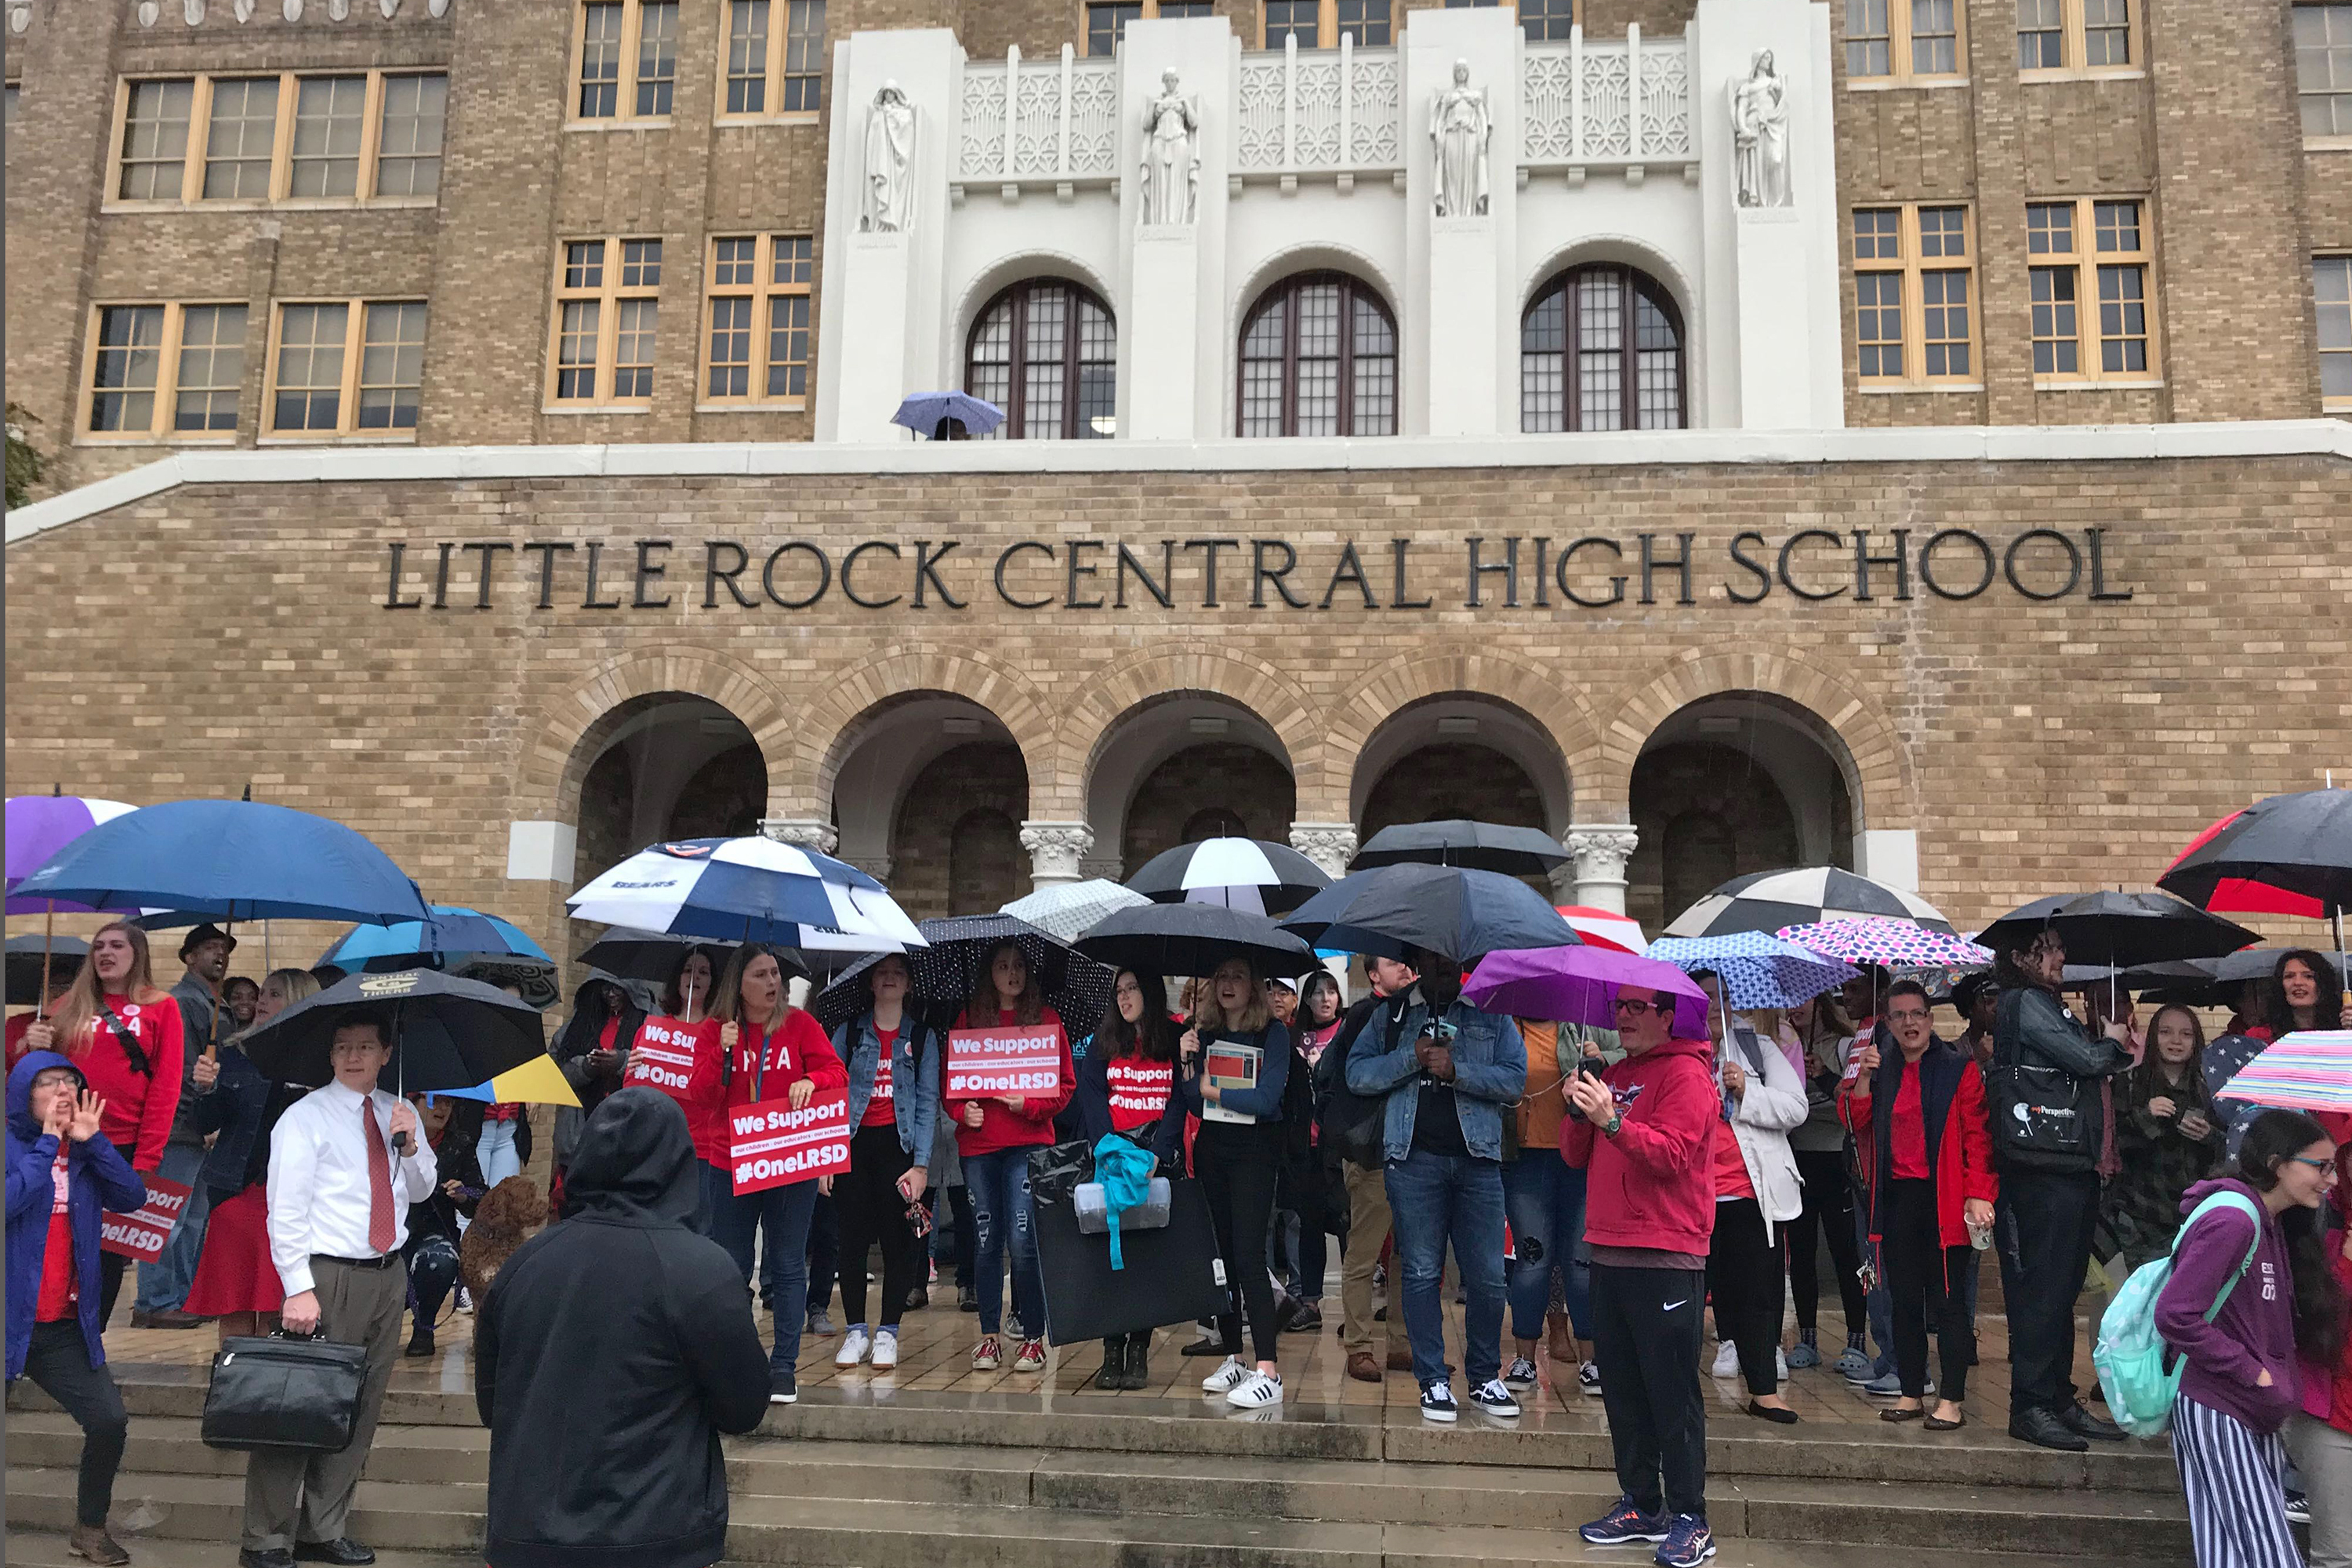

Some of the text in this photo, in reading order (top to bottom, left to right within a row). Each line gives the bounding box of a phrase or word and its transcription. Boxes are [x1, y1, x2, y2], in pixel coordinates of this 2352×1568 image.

[383, 528, 2134, 610] LITTLE ROCK CENTRAL HIGH SCHOOL
[645, 1025, 670, 1044] We
[952, 1034, 1056, 1054] We Support
[950, 1072, 1058, 1091] #OneLRSD
[1123, 1067, 1173, 1083] Support
[733, 1099, 846, 1135] We Support
[746, 1142, 769, 1152] children
[783, 1132, 811, 1144] educators
[824, 1127, 846, 1136] schools
[735, 1143, 848, 1185] #OneLRSD
